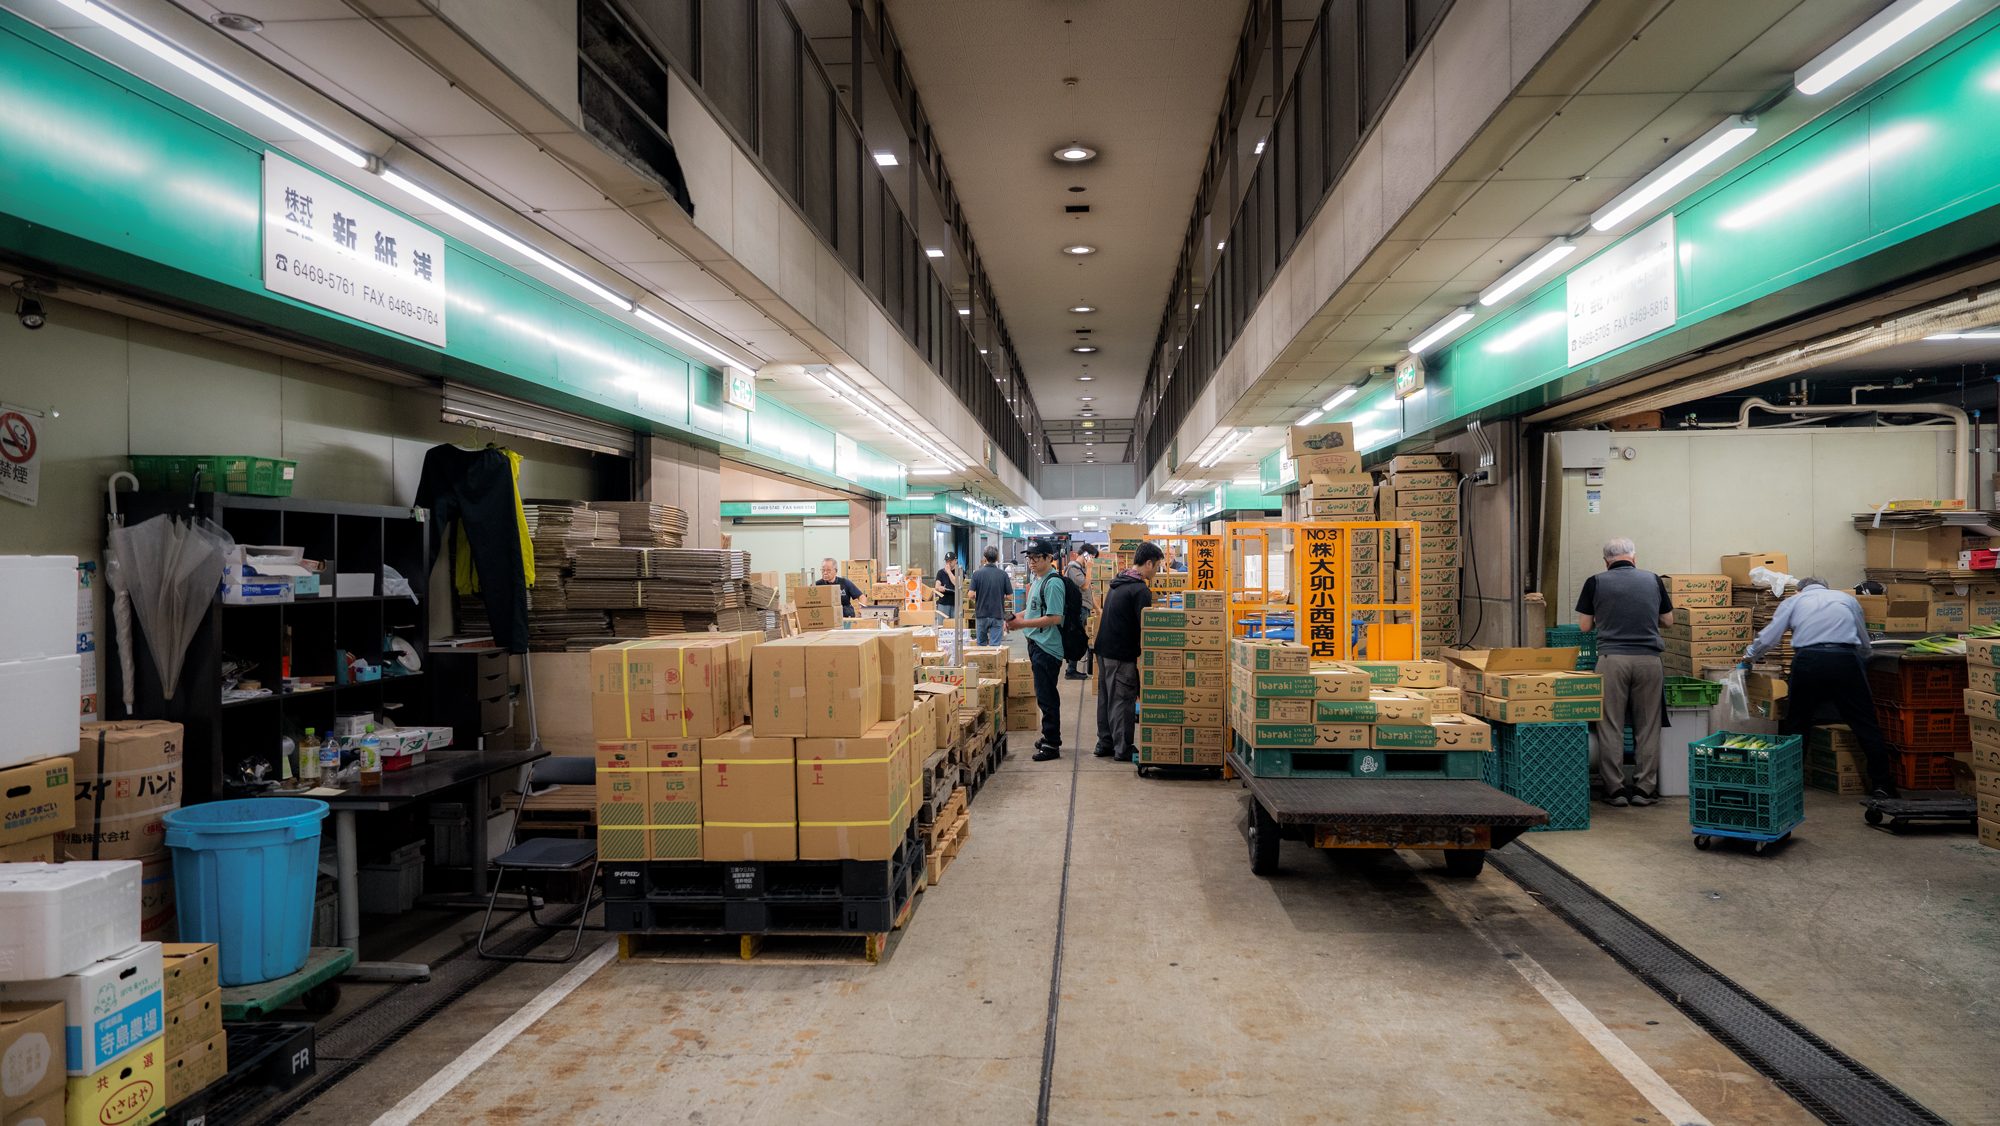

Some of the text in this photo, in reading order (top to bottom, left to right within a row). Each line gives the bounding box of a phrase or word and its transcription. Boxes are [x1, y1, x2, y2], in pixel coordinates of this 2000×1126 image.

[293, 259, 439, 326] 6469-5761 FAX 6469-5764
[0, 460, 28, 485] 禁煙
[1307, 529, 1338, 542] NO.3
[1258, 682, 1292, 690] Ibaraki
[1319, 706, 1353, 715] Ibaraki
[1258, 730, 1292, 739] Ibaraki
[1378, 731, 1413, 740] Ibaraki
[136, 771, 177, 797] バンド
[716, 775, 729, 788] 上
[811, 772, 825, 785] 上
[613, 782, 632, 792] にら
[666, 781, 685, 791] にら
[101, 1008, 157, 1056] 寺島農場
[291, 1047, 310, 1075] FR
